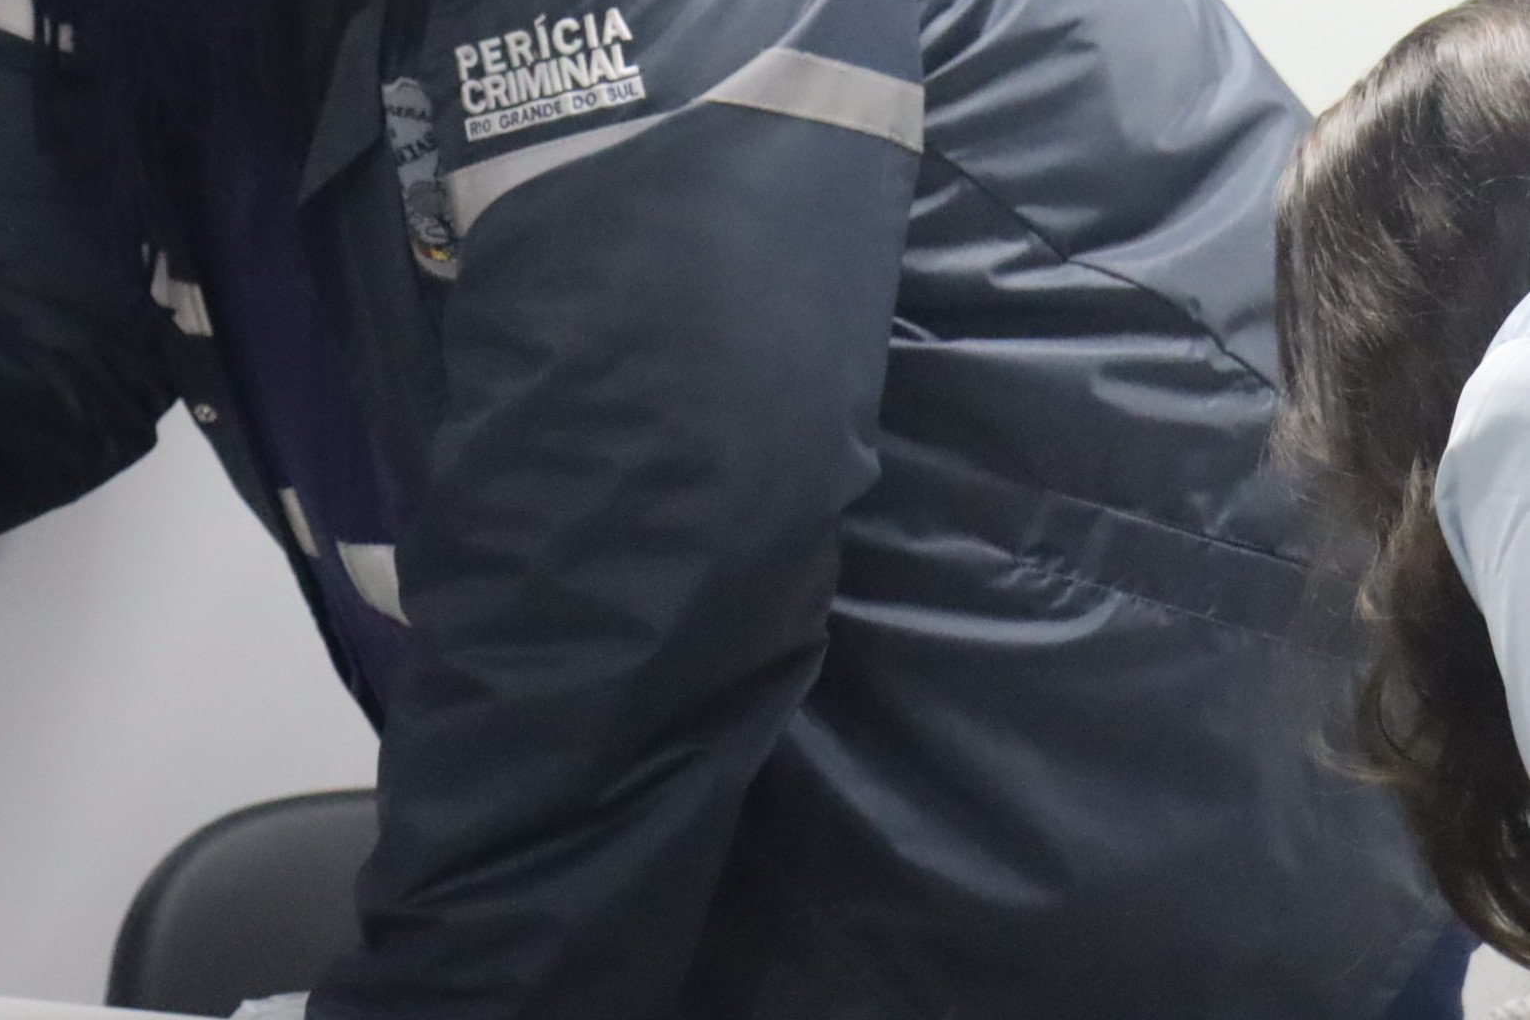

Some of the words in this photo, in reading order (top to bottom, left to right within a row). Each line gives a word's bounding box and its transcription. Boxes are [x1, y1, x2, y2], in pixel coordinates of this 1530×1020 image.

[455, 7, 633, 80] PERÍCIA
[461, 43, 639, 114] CRIMINAL
[470, 118, 491, 136] RIO
[499, 100, 563, 130] GRANDE
[572, 82, 597, 109] DO
[607, 76, 639, 102] SUL
